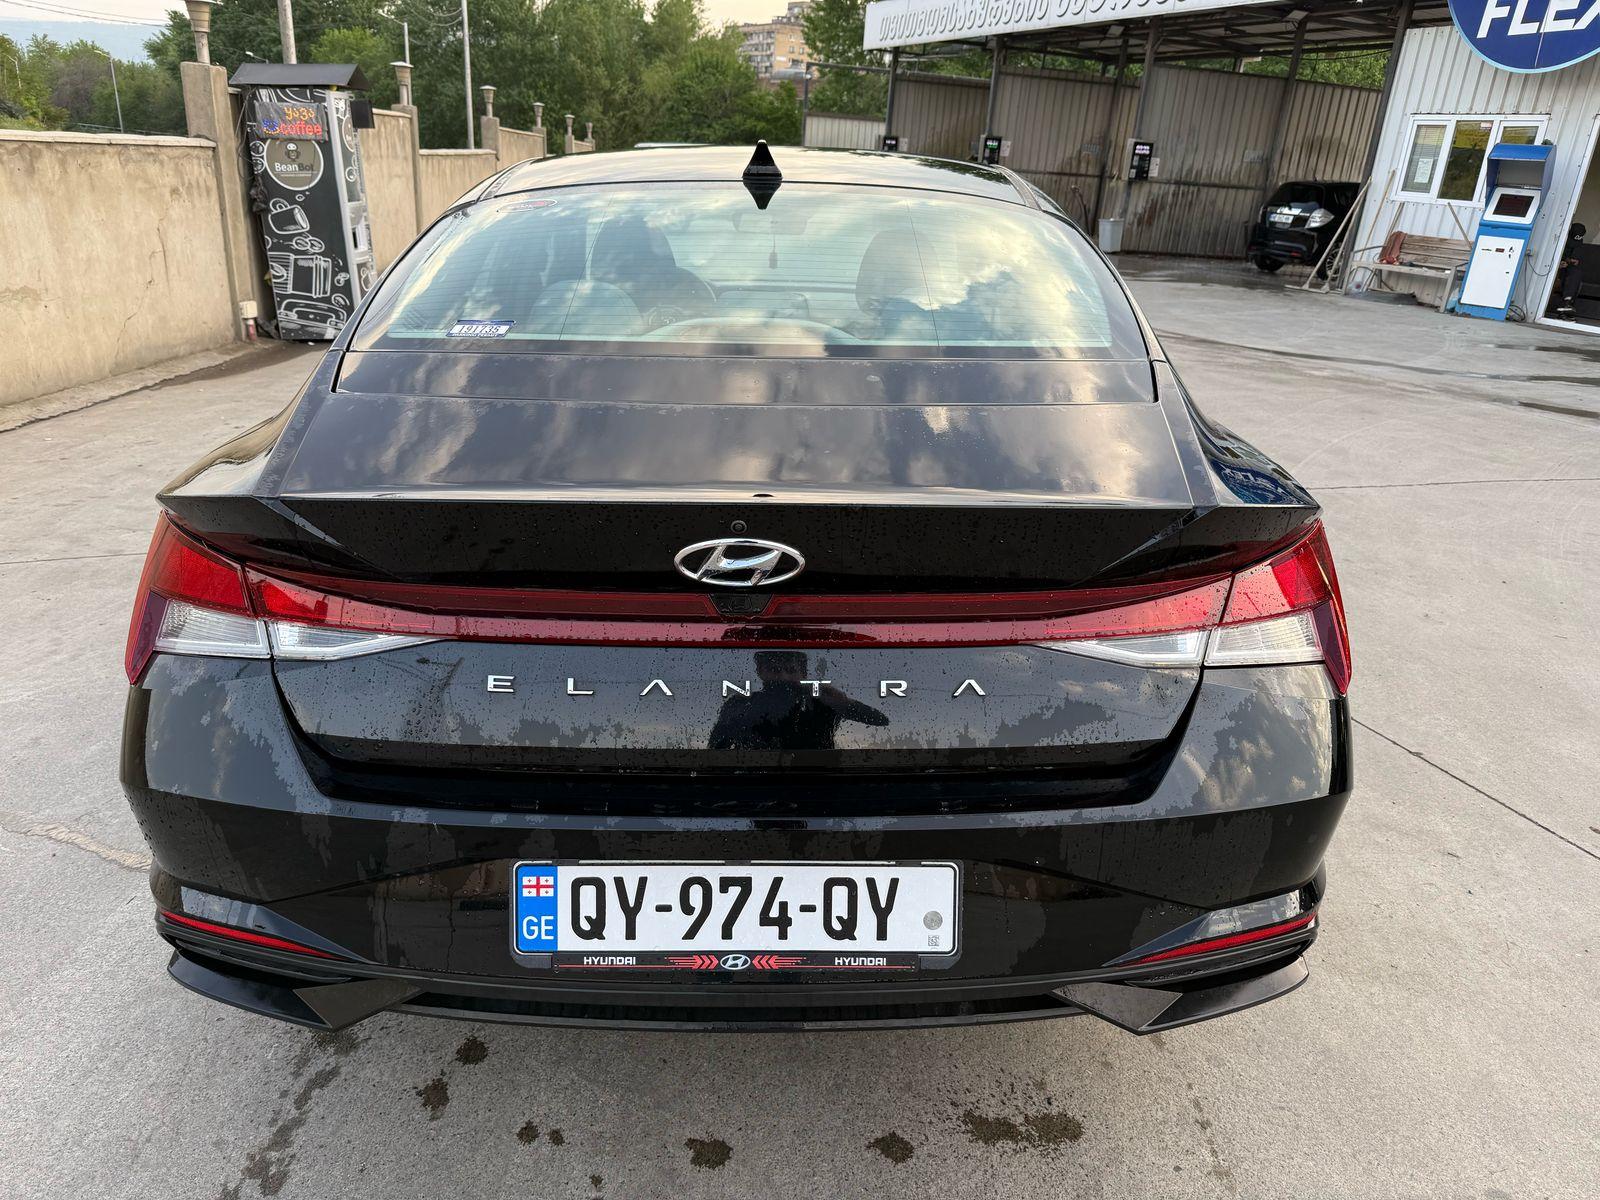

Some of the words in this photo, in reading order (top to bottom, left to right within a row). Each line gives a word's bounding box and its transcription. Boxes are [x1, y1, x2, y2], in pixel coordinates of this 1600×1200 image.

[280, 120, 322, 136] coffee
[487, 674, 985, 697] ELANTRA
[570, 876, 899, 940] QY-974-QY
[522, 915, 554, 940] GE
[583, 956, 635, 965] HYUNDAI
[834, 957, 887, 965] HYUNDAI
